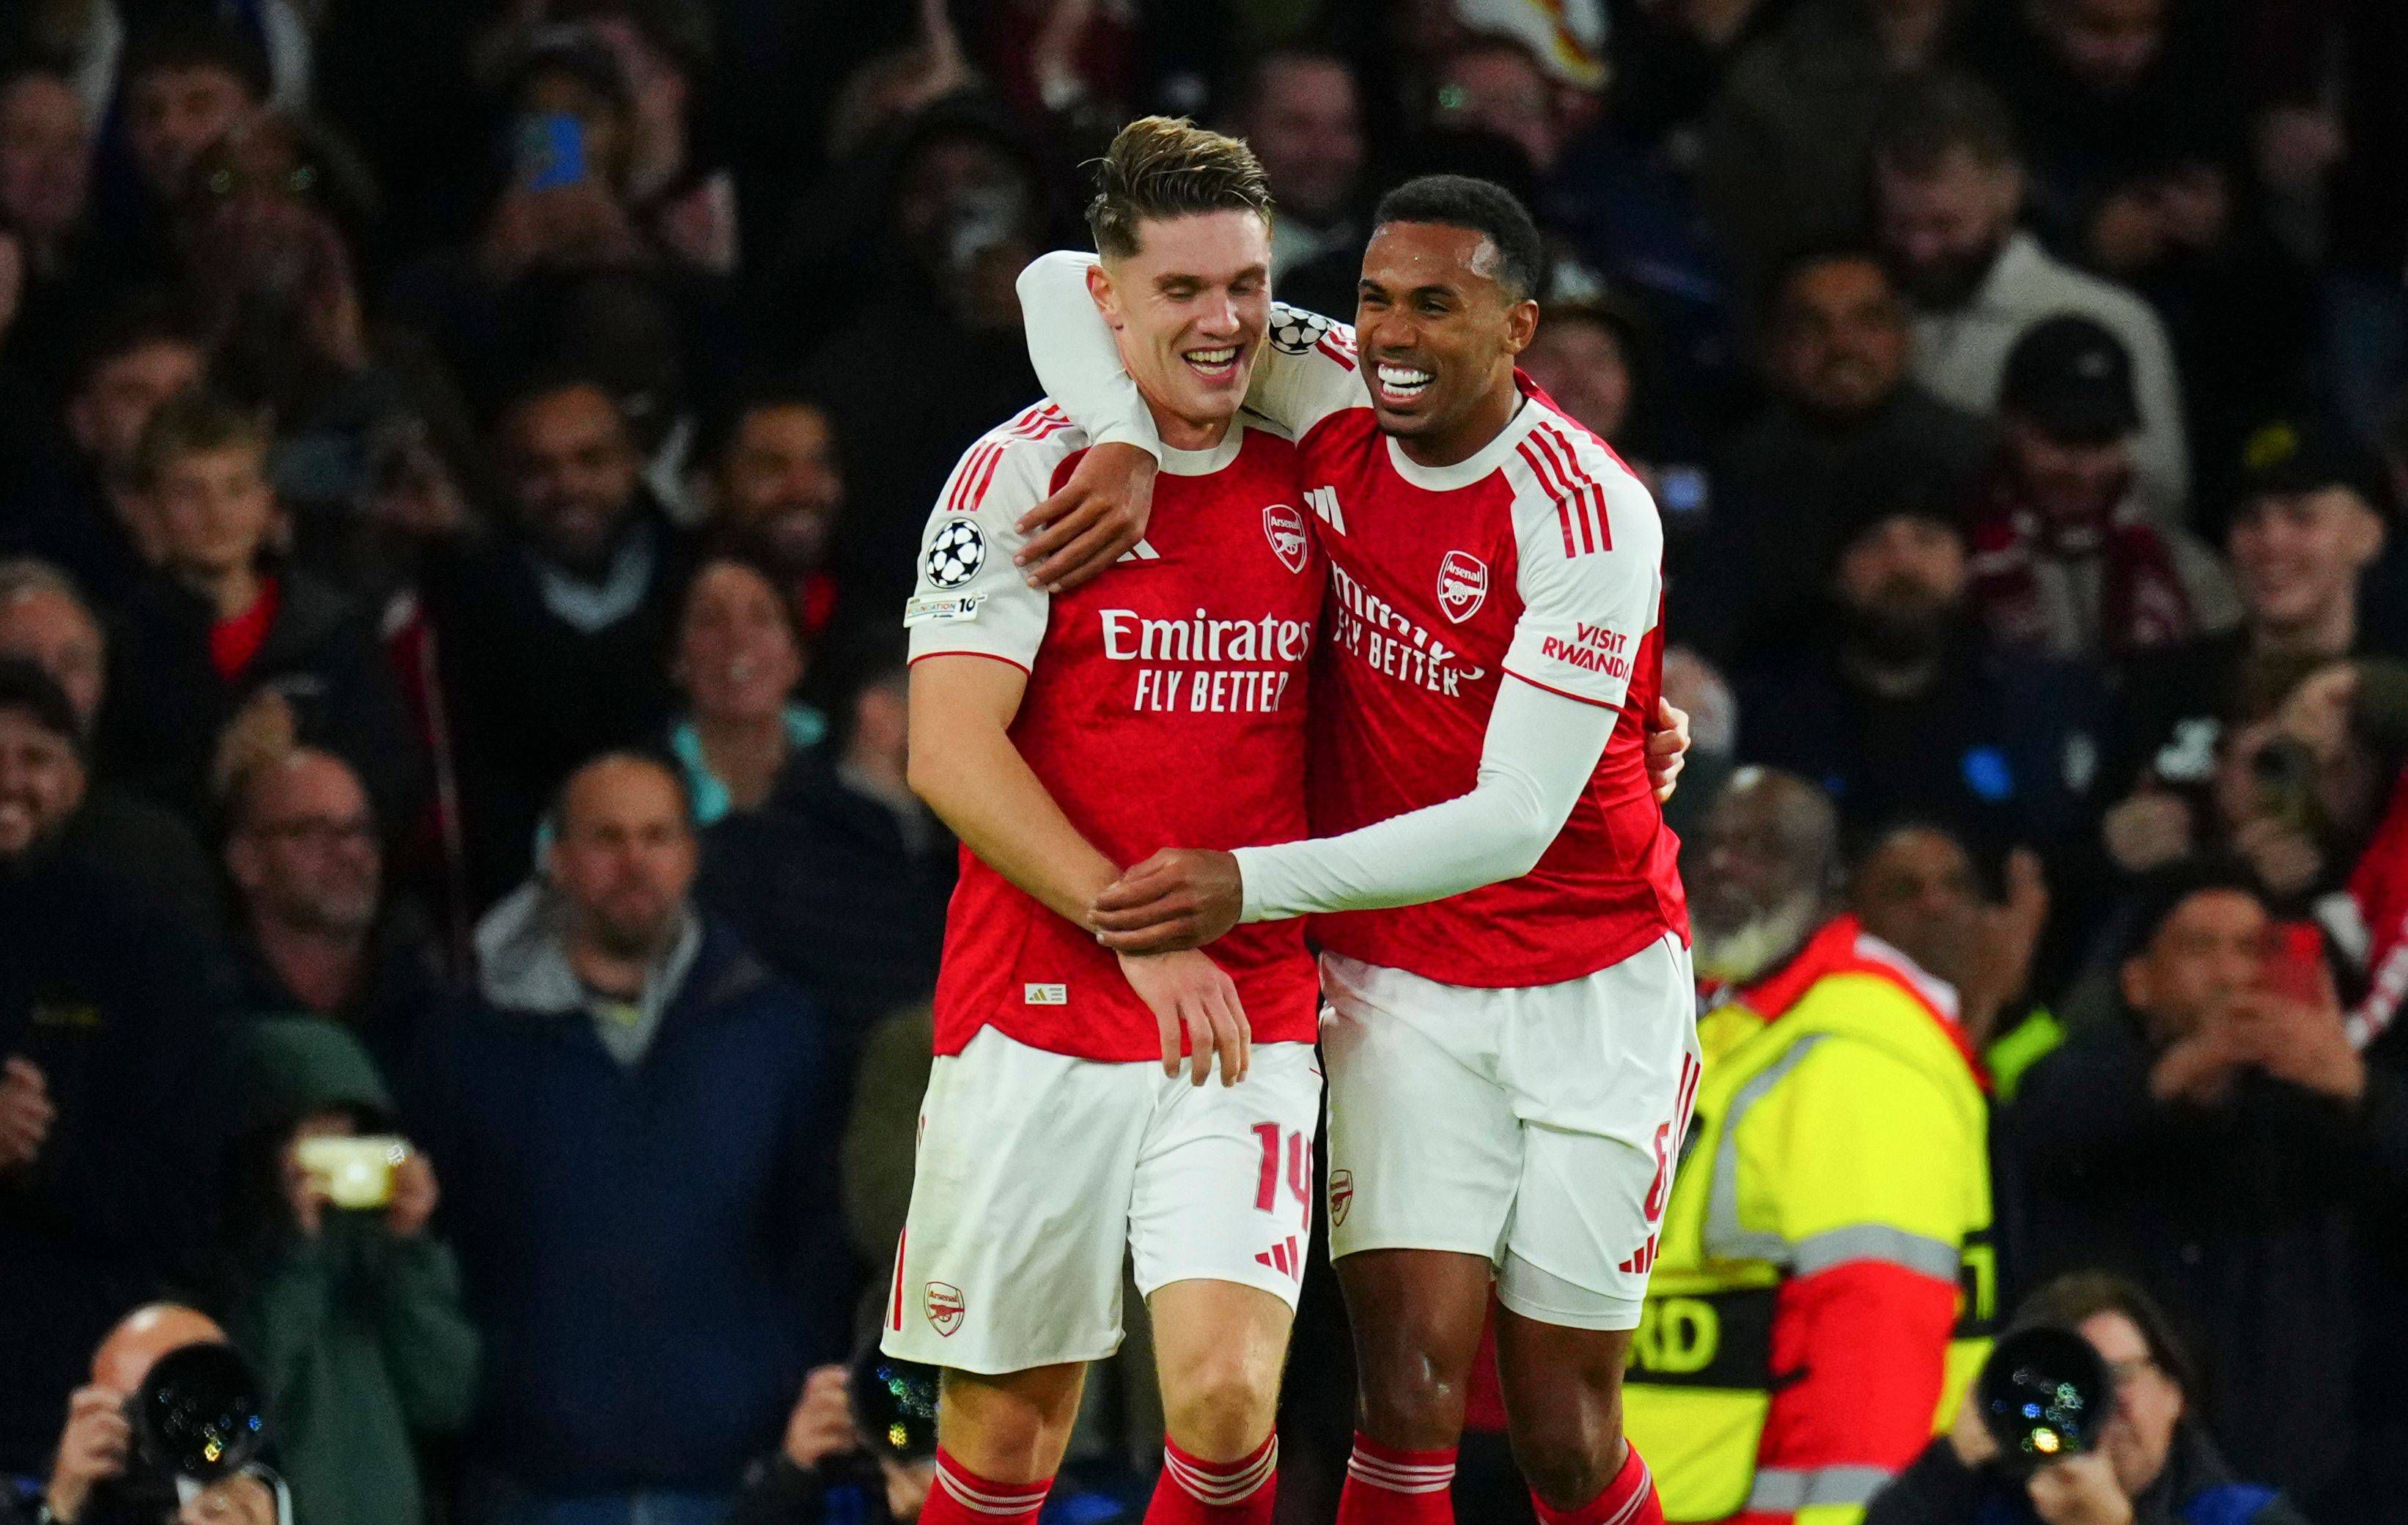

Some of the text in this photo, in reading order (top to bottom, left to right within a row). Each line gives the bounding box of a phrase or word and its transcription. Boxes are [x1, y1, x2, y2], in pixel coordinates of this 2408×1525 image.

[1446, 560, 1480, 583] Arsenal
[1099, 608, 1311, 661] Emirates
[1577, 621, 1627, 654] VISIT
[1369, 630, 1459, 698] BETTER
[1542, 635, 1630, 682] RWANDA
[1134, 669, 1289, 712] FLY BETTER
[1251, 1121, 1313, 1235] 14
